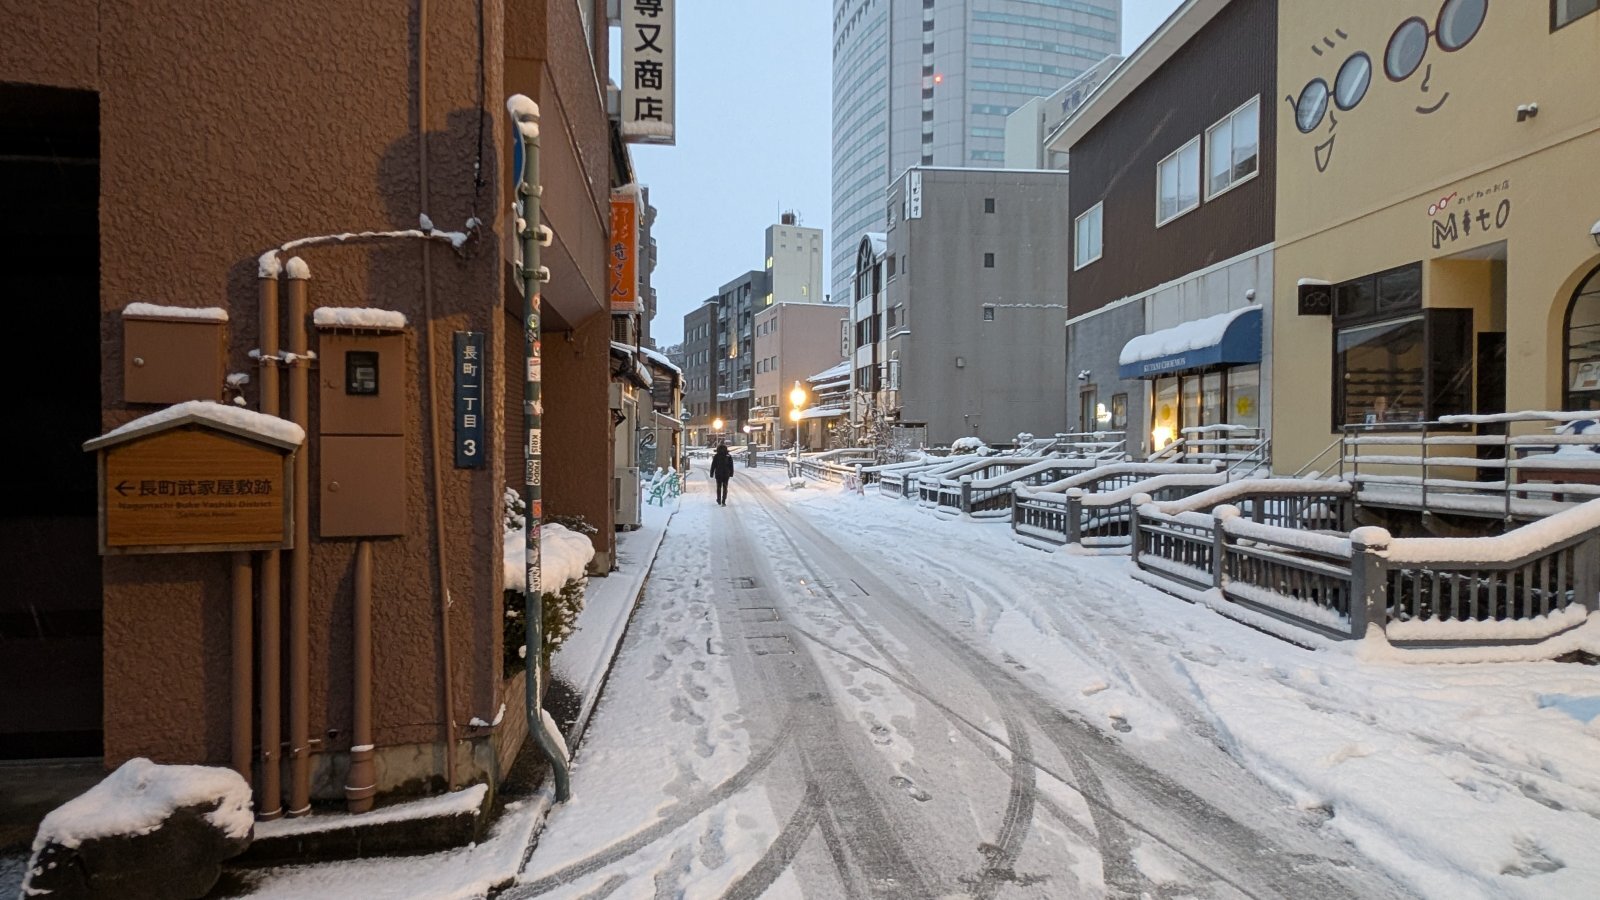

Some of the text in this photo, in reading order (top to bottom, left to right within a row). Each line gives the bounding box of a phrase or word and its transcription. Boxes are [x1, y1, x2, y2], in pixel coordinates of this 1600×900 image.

[462, 345, 478, 456] 長町一丁目 3
[139, 479, 272, 496] 長町武家屋敷跡
